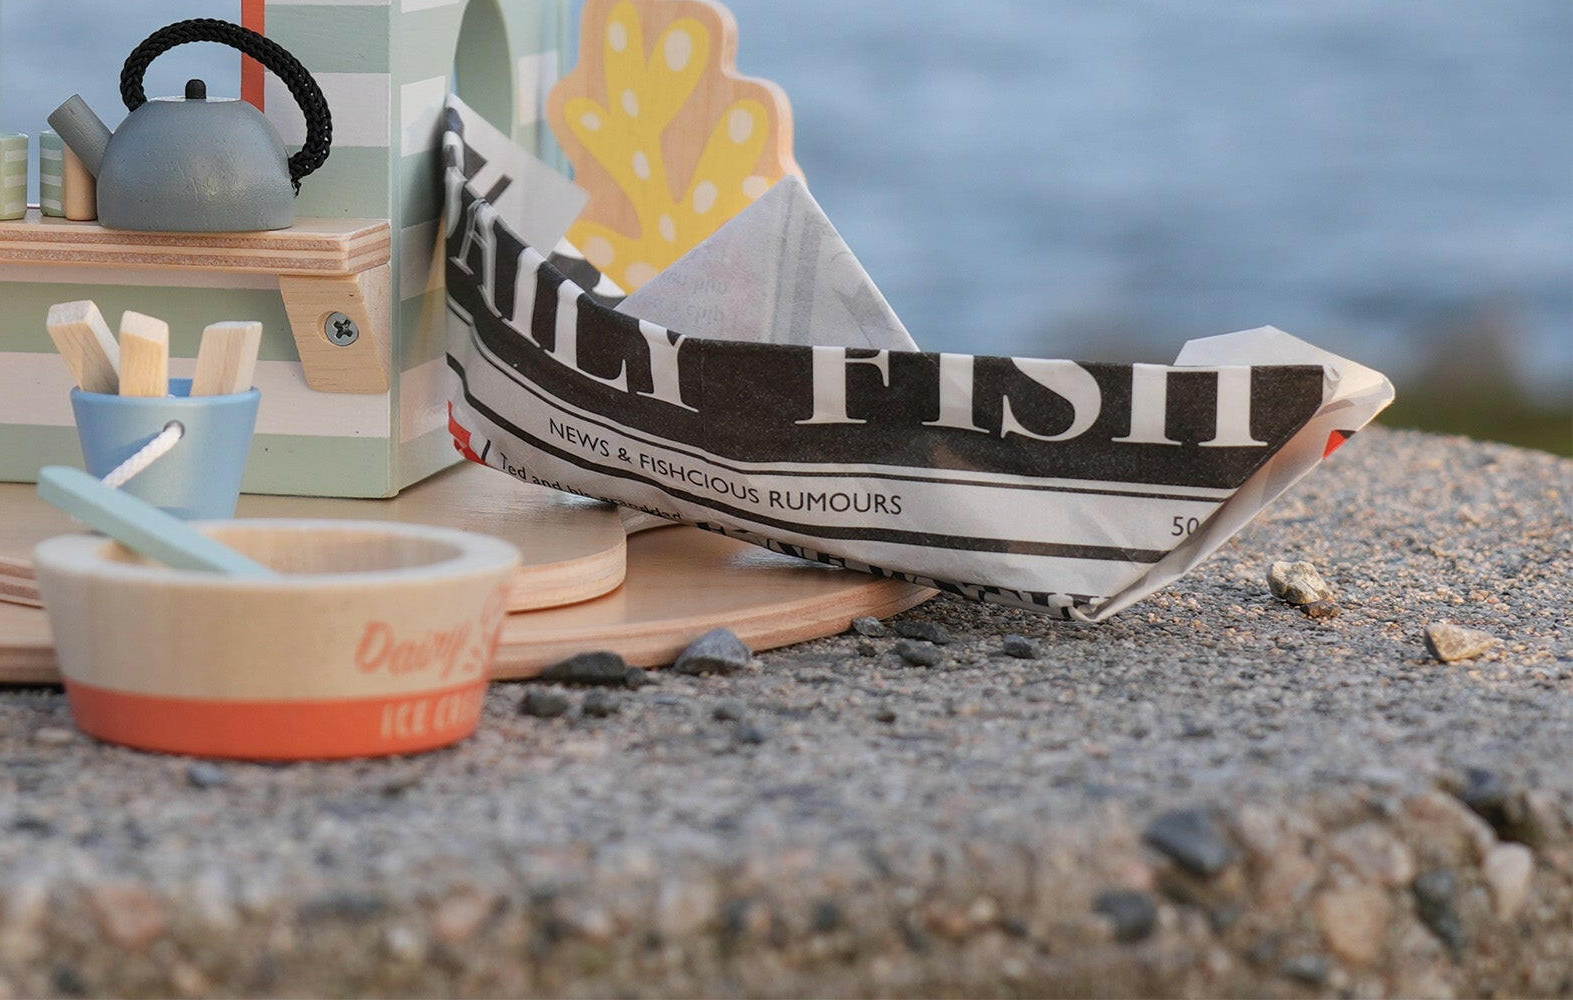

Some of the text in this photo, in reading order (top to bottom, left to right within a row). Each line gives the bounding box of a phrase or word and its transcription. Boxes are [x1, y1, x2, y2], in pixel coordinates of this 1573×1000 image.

[794, 346, 1269, 447] FISH
[500, 451, 527, 481] Ted
[548, 416, 903, 515] NEWS & FISHCIOUS RUMOURS
